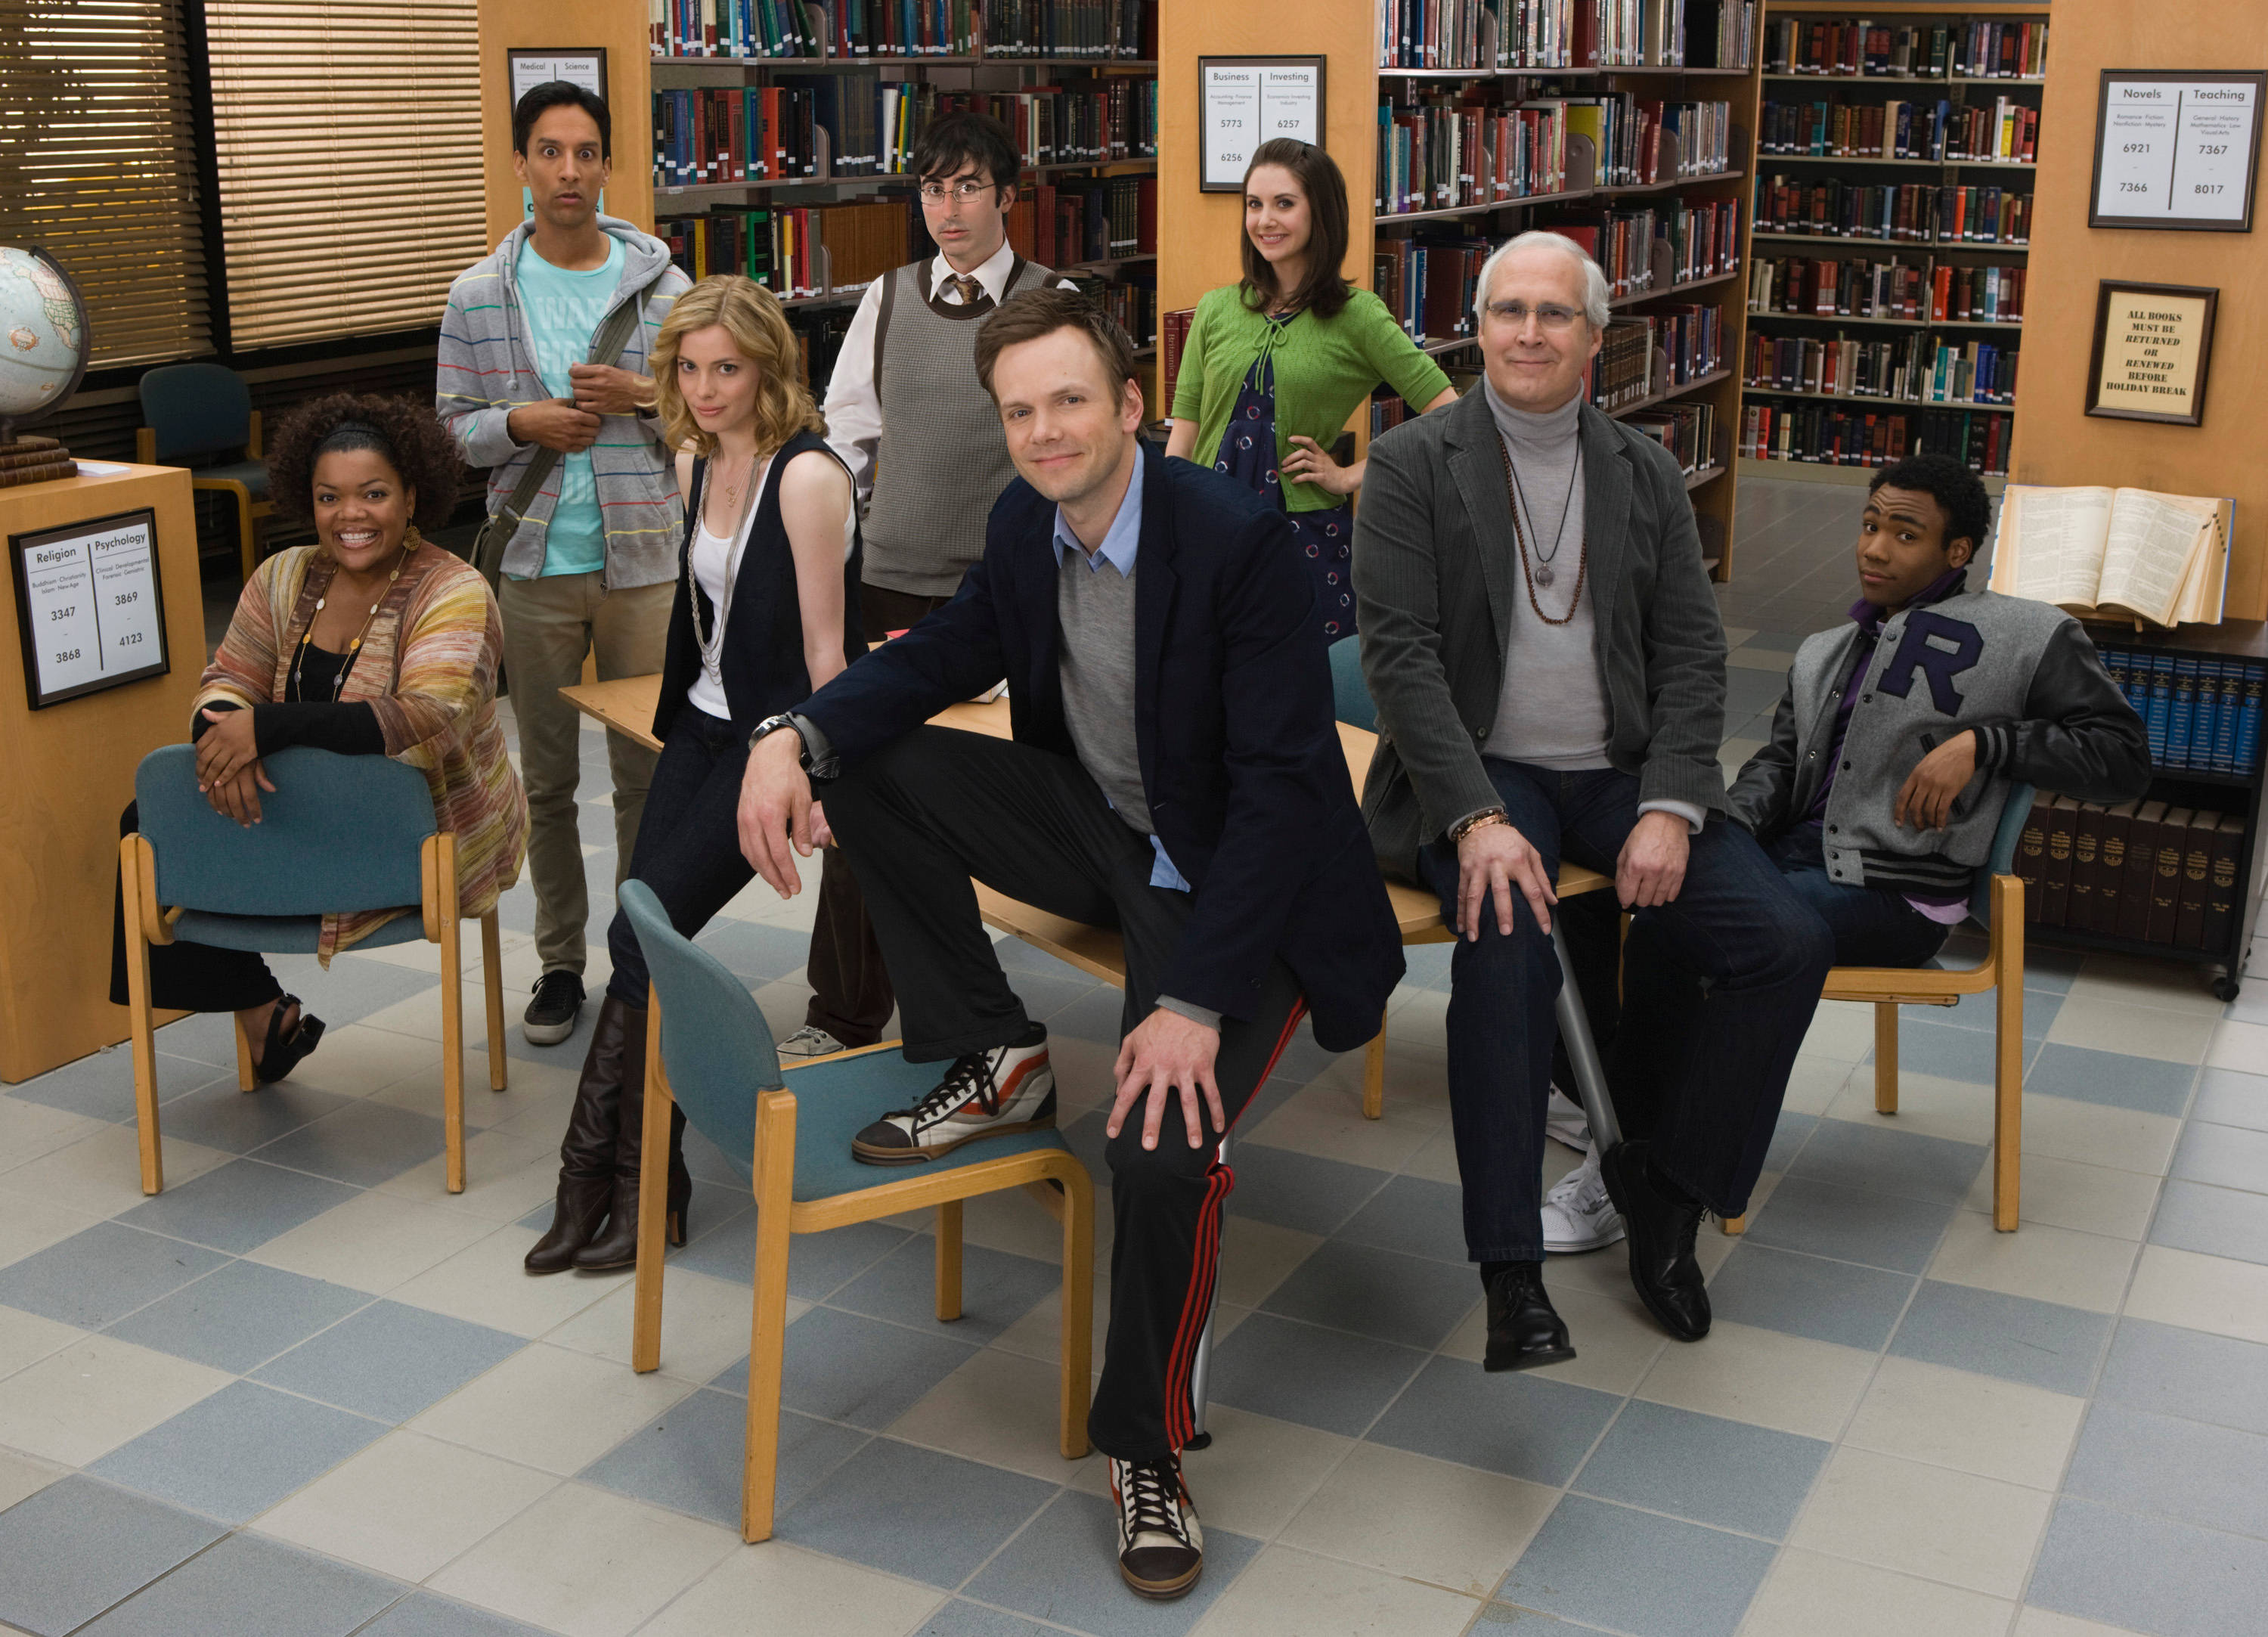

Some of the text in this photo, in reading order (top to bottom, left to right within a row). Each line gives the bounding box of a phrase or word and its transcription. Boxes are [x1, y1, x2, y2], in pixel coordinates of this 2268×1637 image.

[1213, 73, 1249, 81] Business
[1270, 73, 1309, 82] Investing
[2123, 88, 2161, 98] Novels
[2193, 89, 2245, 101] Teaching
[1221, 119, 1242, 128] 5773
[1278, 119, 1300, 128] 6257
[2123, 144, 2150, 153] 6921
[2198, 144, 2228, 154] 7367
[2120, 182, 2147, 192] 7366
[2195, 184, 2224, 194] 8017
[2127, 311, 2183, 321] ALL BOOKS
[2131, 323, 2175, 333] MUST BE
[2125, 335, 2180, 346] RETURNED
[2125, 359, 2174, 370] RENEWED
[2128, 371, 2167, 383] BEFORE
[2106, 382, 2186, 395] HOLIDAY BREAK
[94, 532, 146, 550] Psychology
[36, 547, 76, 563] Religion
[32, 572, 86, 588] Buddhism Christianity
[115, 591, 138, 606] 3869
[51, 606, 76, 622] 3347
[119, 632, 142, 646] 4123
[56, 649, 81, 664] 3868
[1876, 610, 1984, 717] R
